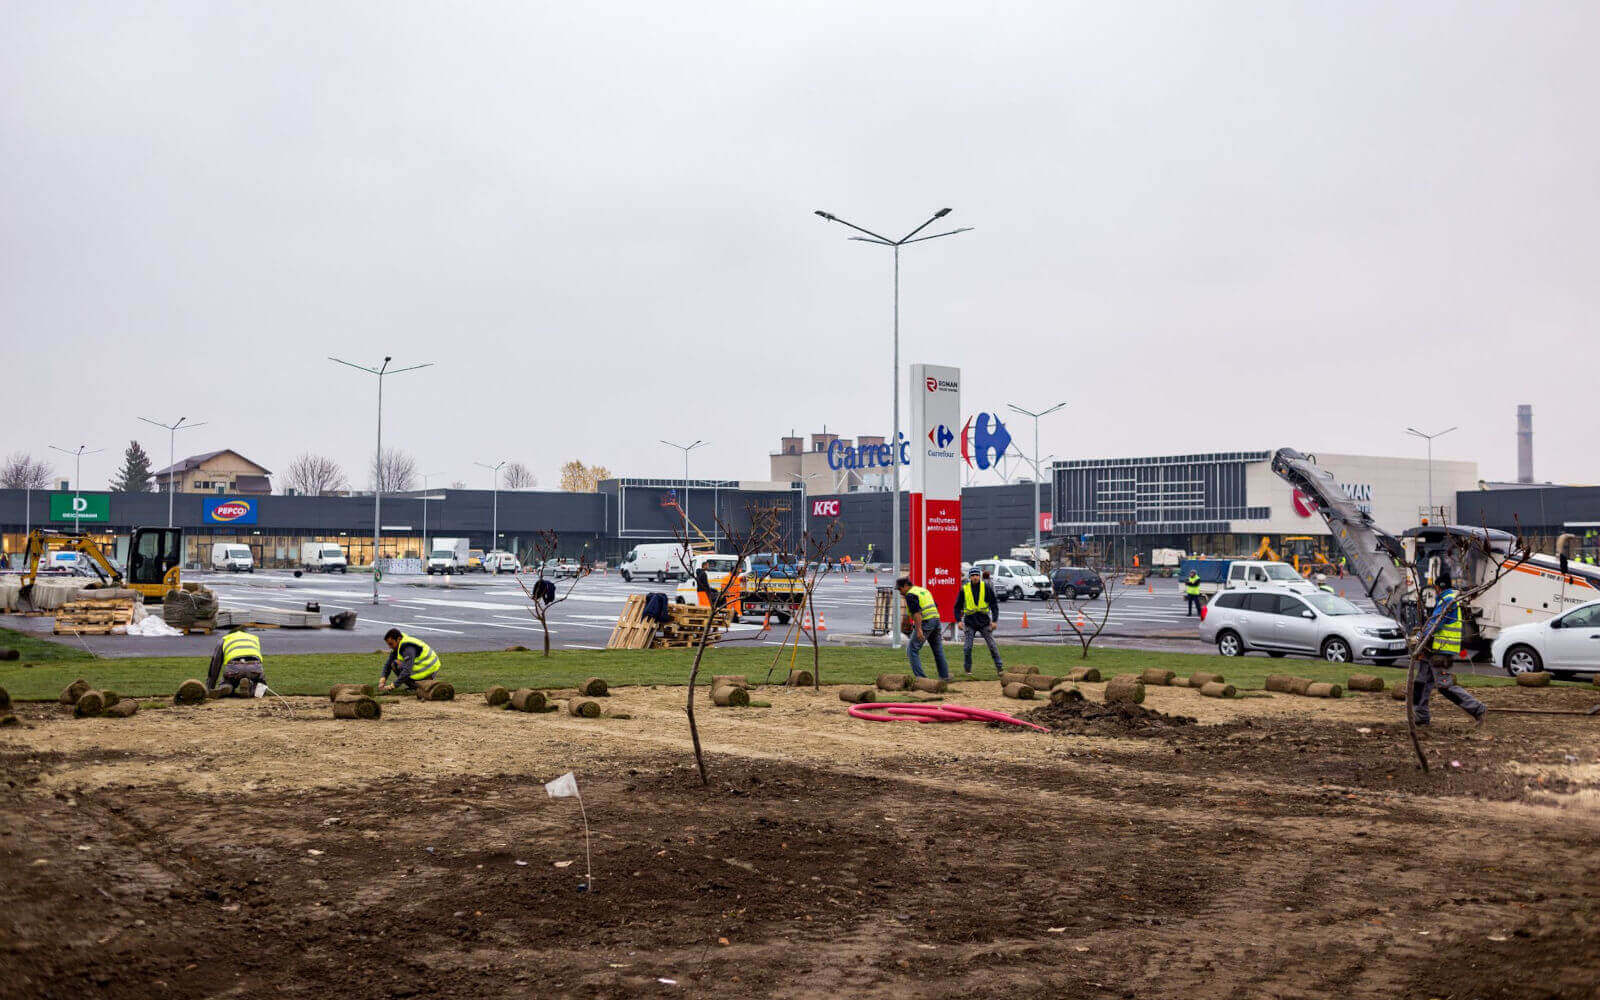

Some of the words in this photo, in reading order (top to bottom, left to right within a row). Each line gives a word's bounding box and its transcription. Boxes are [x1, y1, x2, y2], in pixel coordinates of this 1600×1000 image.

[939, 380, 958, 388] ROMAN
[827, 432, 910, 470] Carrefo
[928, 449, 954, 458] Carrefour
[1341, 481, 1373, 501] MAN
[73, 497, 88, 511] D
[813, 500, 840, 516] KFC
[217, 506, 243, 515] PEPCO
[934, 567, 949, 576] Bine
